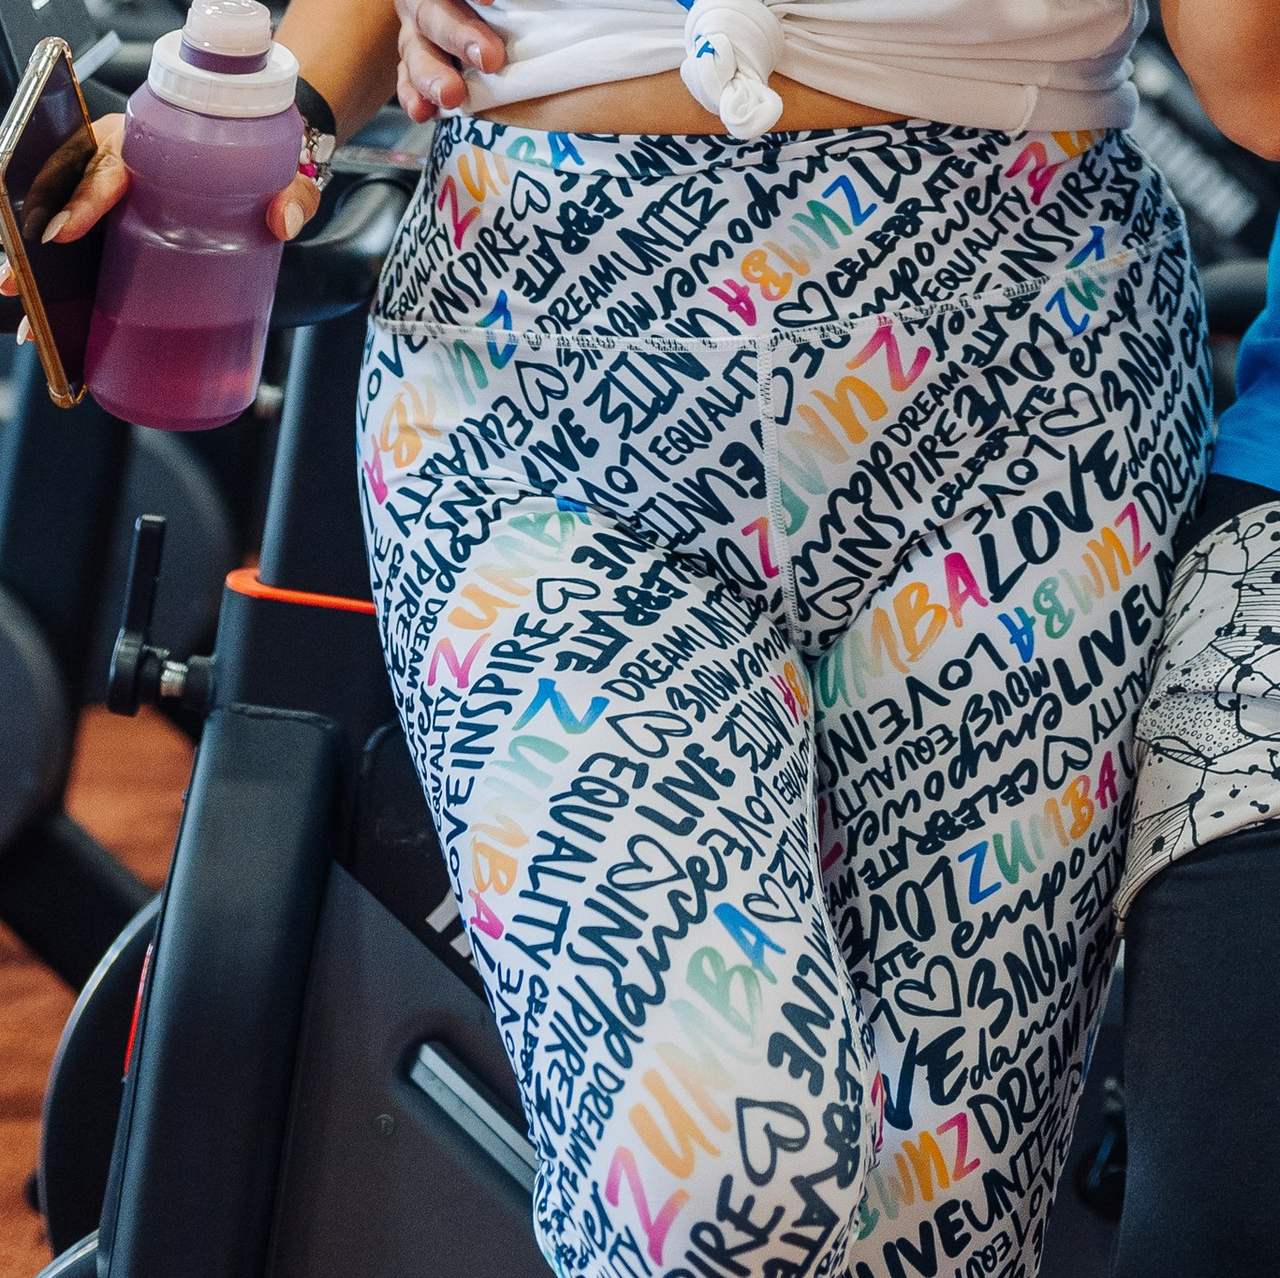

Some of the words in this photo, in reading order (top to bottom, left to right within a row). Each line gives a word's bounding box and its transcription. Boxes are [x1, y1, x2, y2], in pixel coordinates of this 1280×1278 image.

[428, 206, 529, 328] INSPIRE
[707, 174, 877, 326] ZUMBA
[828, 156, 978, 297] CELEBRATE
[922, 186, 1031, 301] EQUALITY
[999, 149, 1107, 285] INSPIRE
[544, 264, 617, 335] DREAM
[883, 360, 967, 446] DREAM
[931, 385, 1058, 520] CELEBRATE
[979, 429, 1129, 603] LOVE
[998, 502, 1151, 663] ZUMBA
[450, 612, 569, 770] INSPIRE
[601, 625, 705, 701] DREAM
[870, 632, 1008, 736] LOVE
[1053, 584, 1151, 706] LIVE
[469, 677, 610, 940] ZUMBA
[634, 743, 737, 837] LIVE
[698, 776, 790, 871] LOVE
[831, 723, 958, 830] EQUALITY
[845, 688, 1063, 864] empower
[858, 758, 1039, 891] CELEBRATE
[958, 751, 1117, 905] ZUMBA
[505, 752, 650, 970] EQUALITY
[575, 846, 727, 1069] dance
[766, 953, 841, 1096] LIVE
[605, 901, 786, 1266] ZUMBA
[967, 1003, 1081, 1154] DREAM
[969, 978, 1078, 1090] dance
[566, 1062, 625, 1177] DREAM
